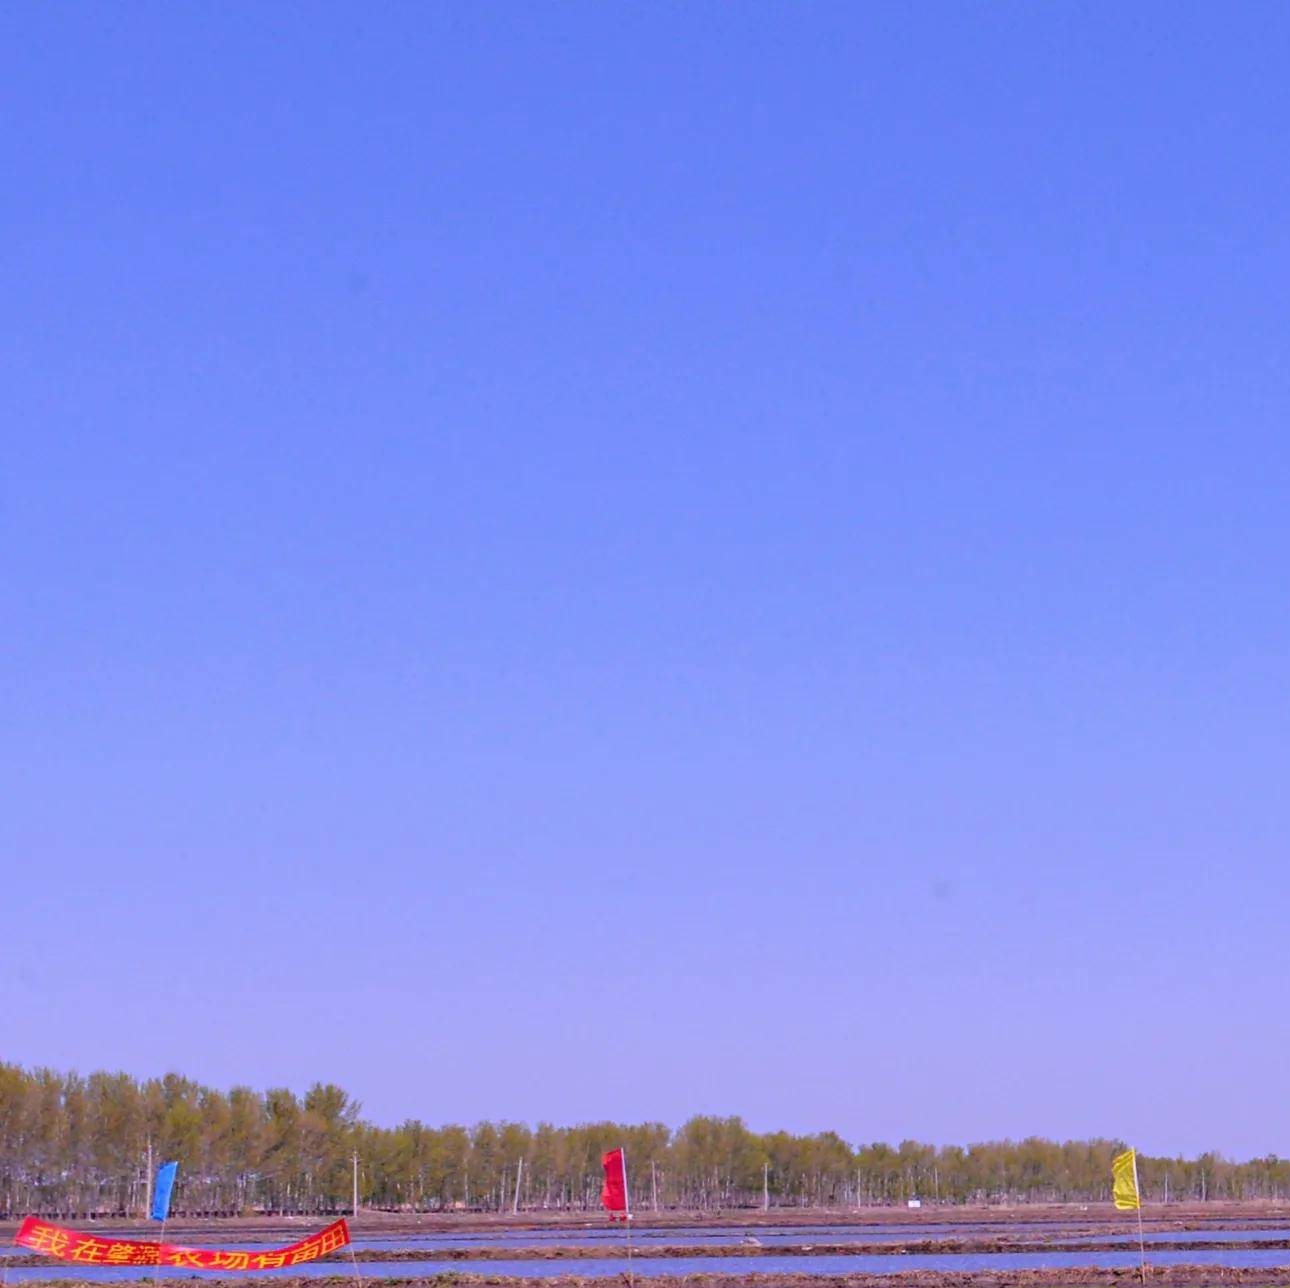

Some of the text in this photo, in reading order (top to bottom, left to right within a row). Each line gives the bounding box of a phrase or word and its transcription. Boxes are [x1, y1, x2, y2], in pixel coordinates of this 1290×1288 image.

[30, 1224, 346, 1269] 我在肇源农场有亩田
